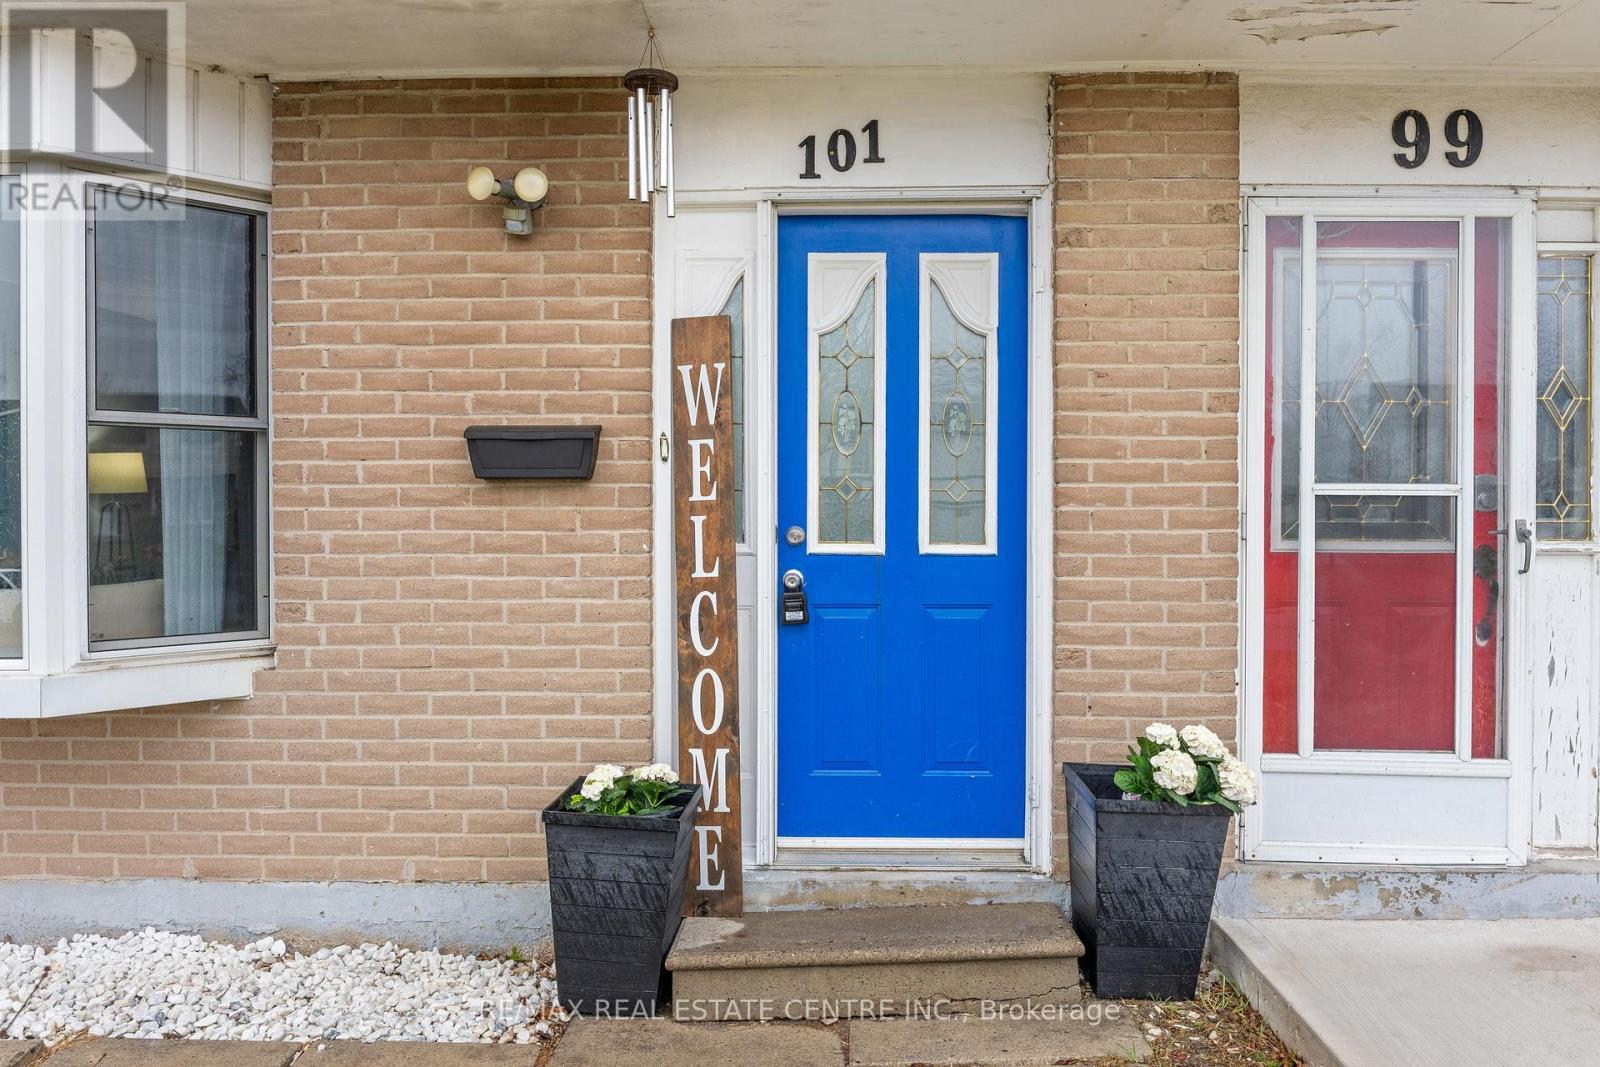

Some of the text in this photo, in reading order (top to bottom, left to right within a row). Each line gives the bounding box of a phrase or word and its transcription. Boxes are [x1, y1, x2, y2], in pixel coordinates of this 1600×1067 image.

[798, 119, 885, 179] 101
[1391, 108, 1484, 170] 99
[677, 362, 731, 891] WELCOME
